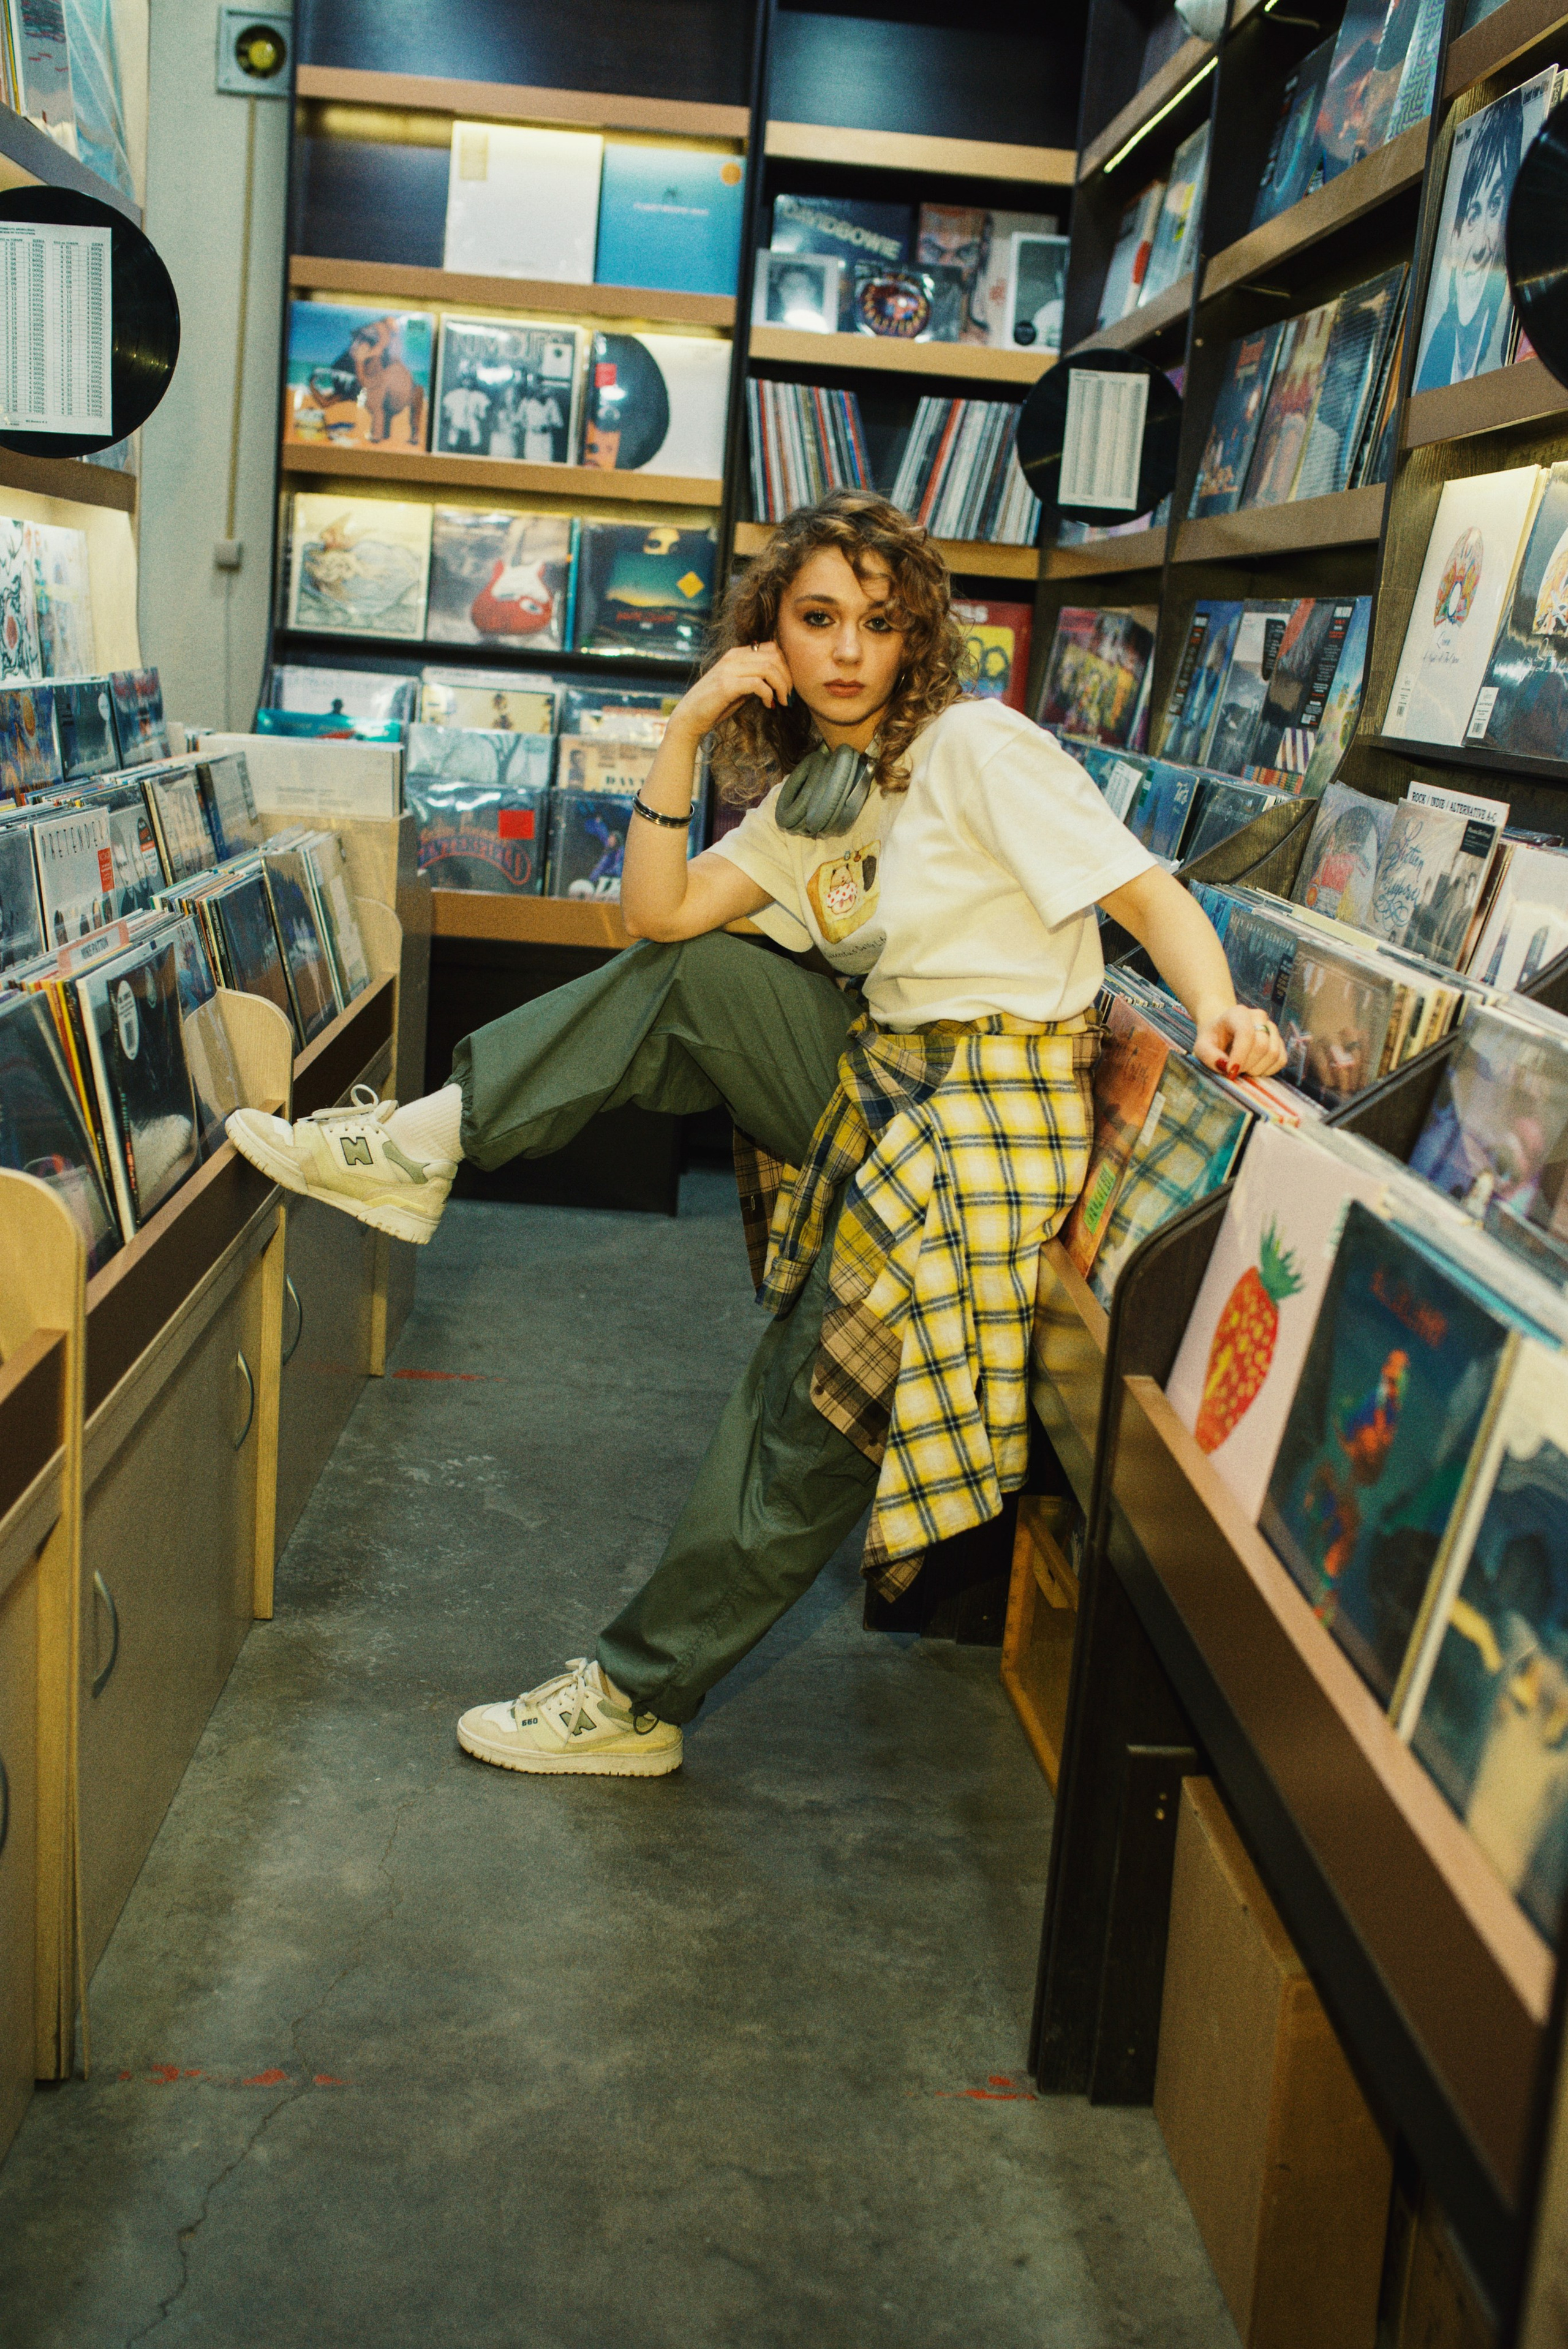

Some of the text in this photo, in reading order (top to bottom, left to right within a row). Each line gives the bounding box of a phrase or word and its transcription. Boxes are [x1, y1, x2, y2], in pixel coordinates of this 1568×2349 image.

[1412, 792, 1426, 804] ROCK
[1430, 796, 1446, 809] INDIE
[1449, 802, 1487, 820] ALTERNATIVE
[1487, 812, 1498, 823] A-C
